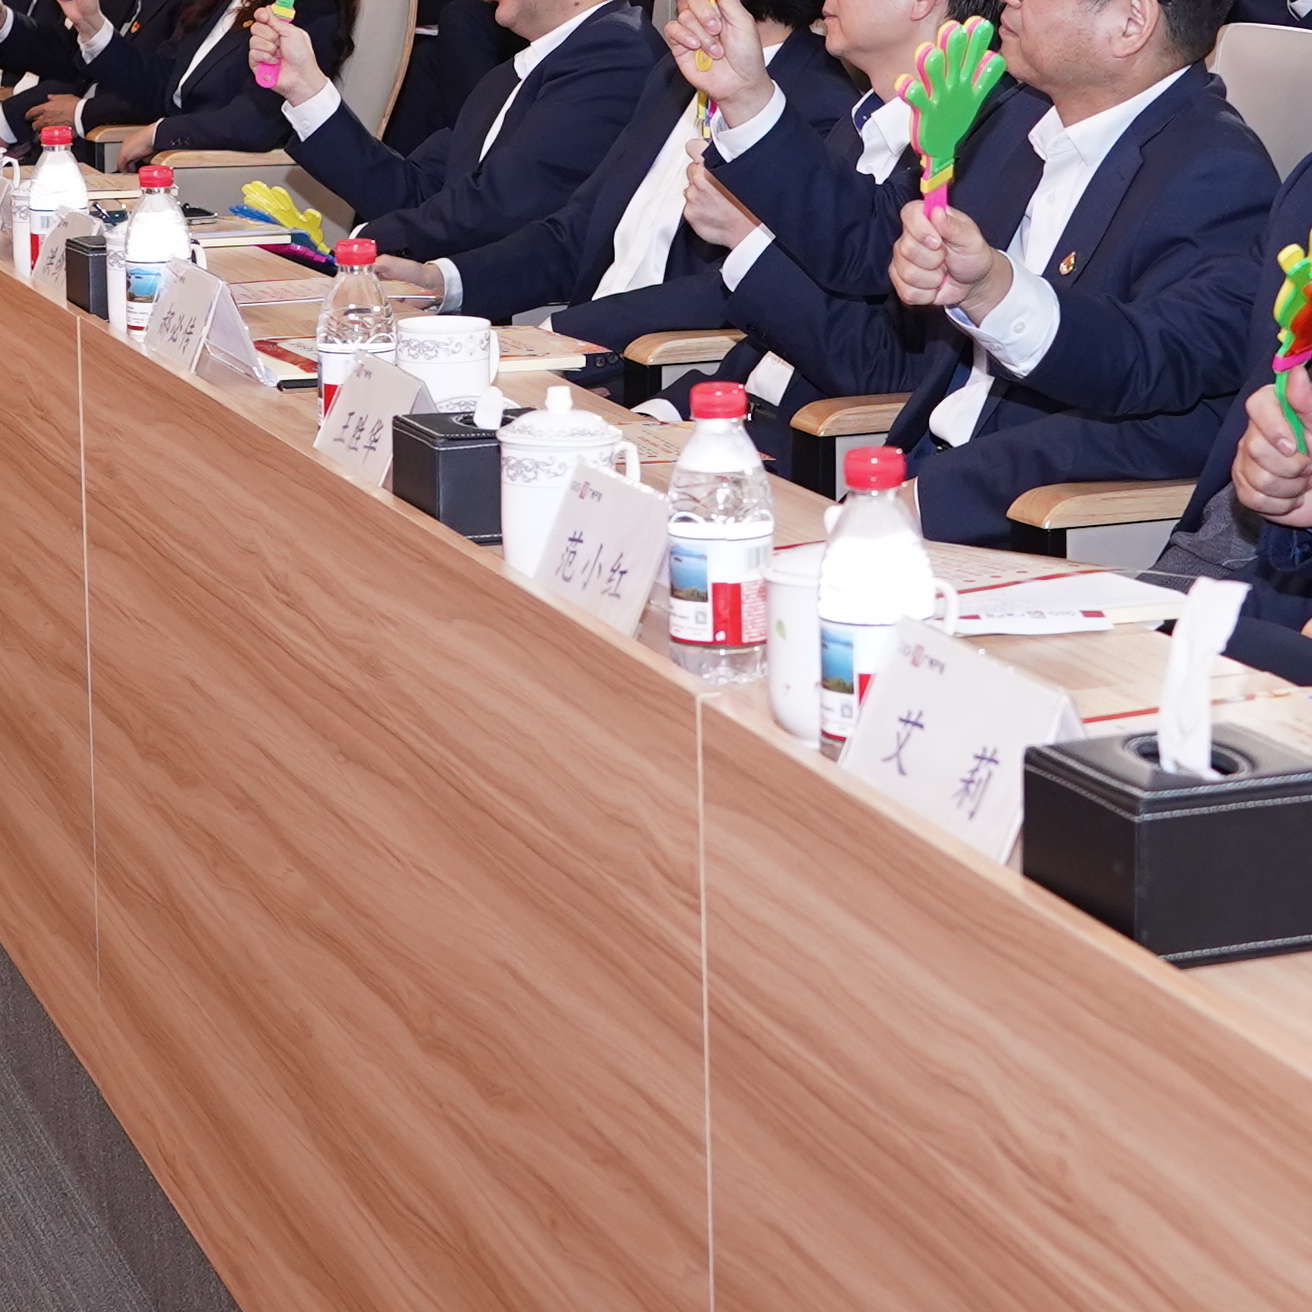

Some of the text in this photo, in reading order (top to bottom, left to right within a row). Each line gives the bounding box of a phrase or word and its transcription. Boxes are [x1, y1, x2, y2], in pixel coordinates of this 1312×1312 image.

[554, 530, 629, 600] 范小红
[880, 709, 1001, 821] 艾莉
